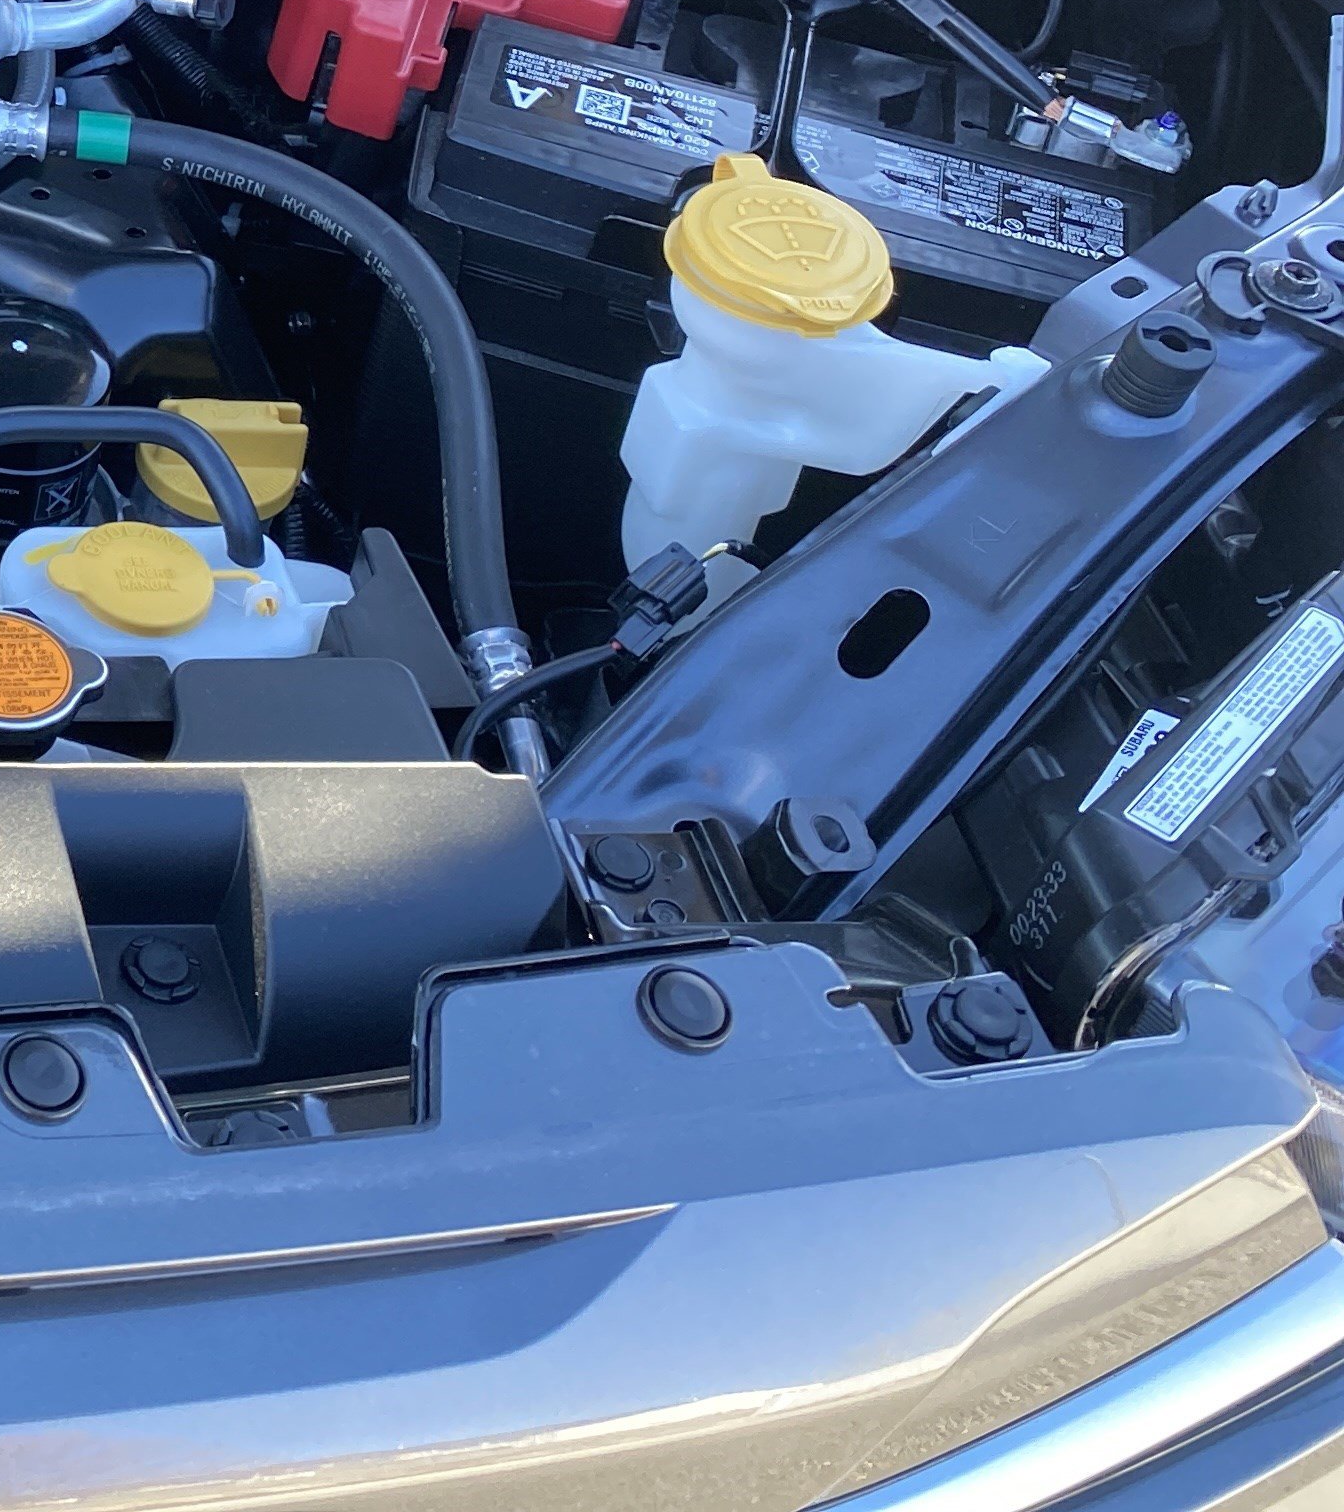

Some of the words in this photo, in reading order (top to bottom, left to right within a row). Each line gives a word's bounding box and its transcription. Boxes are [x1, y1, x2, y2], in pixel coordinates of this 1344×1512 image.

[624, 78, 717, 108] 82110AN00B
[652, 95, 670, 105] AH
[584, 118, 618, 133] AMPS
[684, 113, 713, 128] LN2
[618, 127, 676, 147] CRANKING
[637, 121, 682, 140] AMPS
[677, 143, 709, 156] COLD
[683, 134, 710, 148] 620
[965, 217, 1089, 258] DANGER/POISON
[799, 296, 851, 311] PULL
[82, 525, 193, 557] COOLANT
[959, 514, 1018, 555] KL
[1120, 718, 1155, 757] SUBARU
